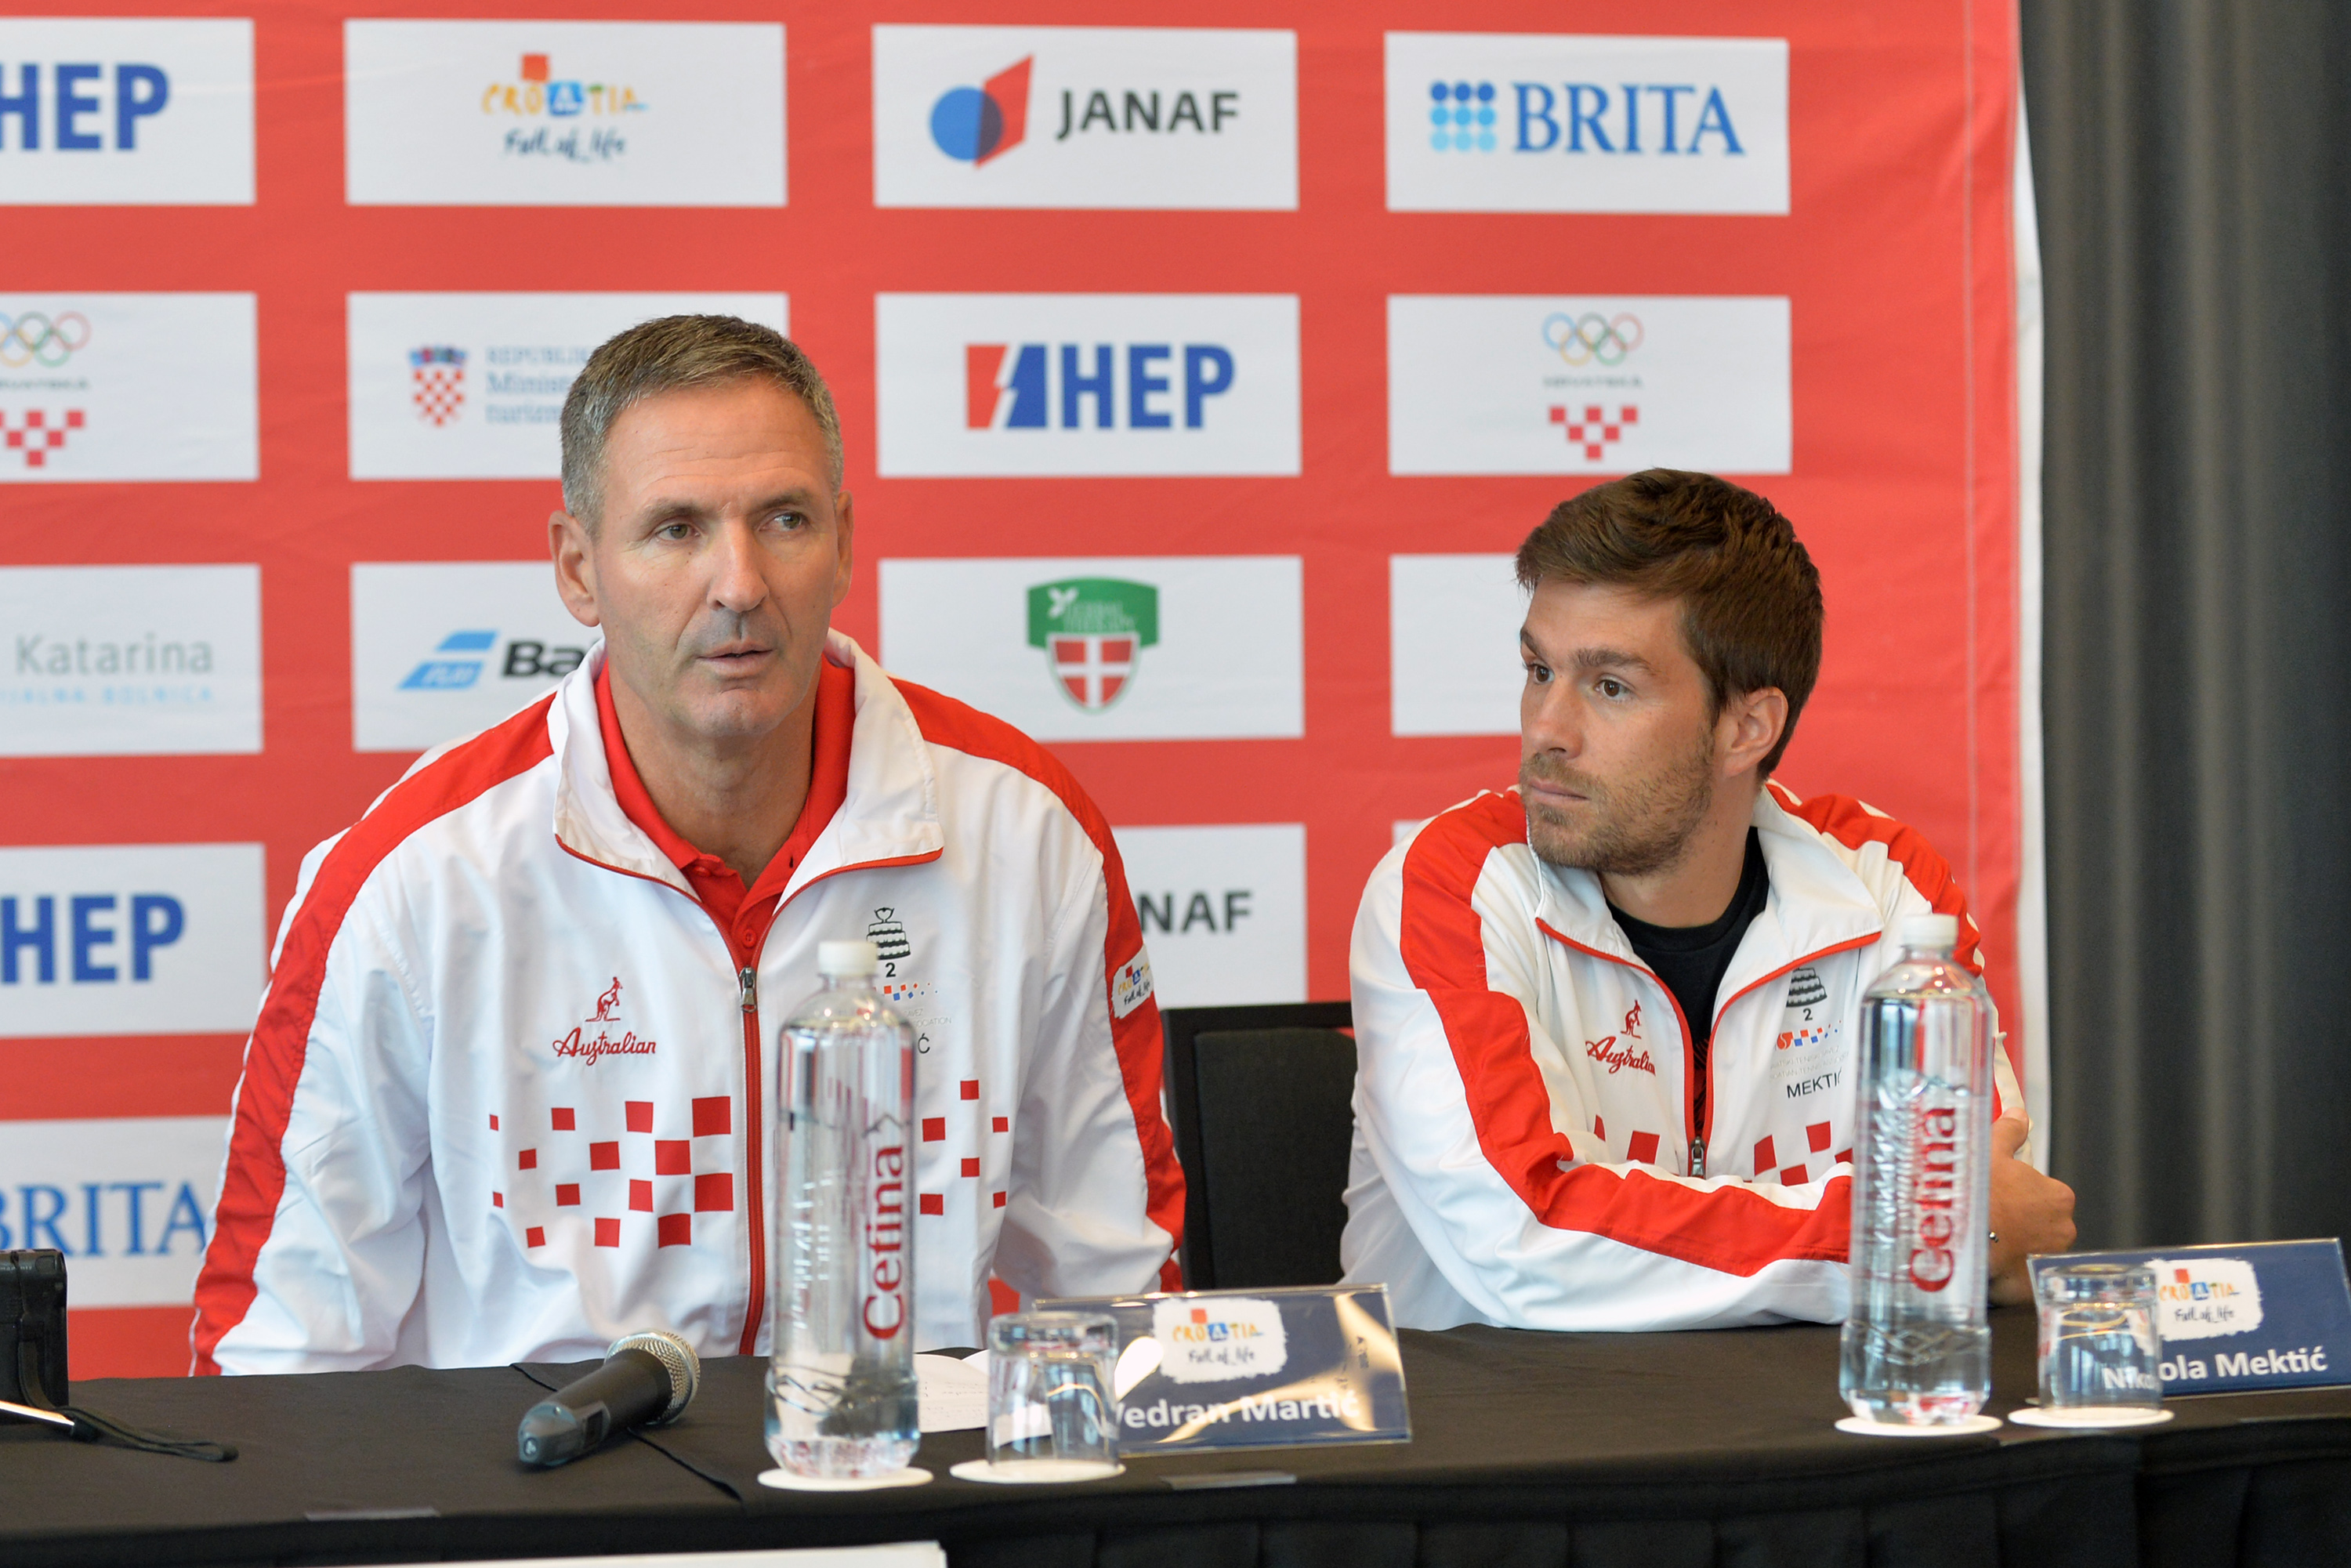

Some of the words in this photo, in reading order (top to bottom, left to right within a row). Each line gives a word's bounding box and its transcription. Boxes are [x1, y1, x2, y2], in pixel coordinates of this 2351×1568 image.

[0, 63, 170, 150] HEP
[481, 81, 648, 118] CROATIA
[1055, 89, 1241, 143] JANAF
[1512, 81, 1747, 156] BRITA
[1059, 342, 1236, 430] HEP
[15, 631, 214, 676] Katarina
[1139, 889, 1253, 934] NAF
[0, 893, 186, 984] HEP
[884, 961, 897, 979] 2
[1802, 1007, 1814, 1022] 2
[552, 1027, 657, 1066] Australian
[0, 1179, 206, 1258] RITA
[1908, 1106, 1956, 1294] Cetina
[862, 1144, 905, 1342] Cetina
[2159, 1281, 2241, 1301] CROATIA
[2174, 1305, 2198, 1322] Full
[1172, 1322, 1264, 1342] CROATIA
[2214, 1345, 2328, 1378] Mektić
[1238, 1389, 1362, 1423] Martić
